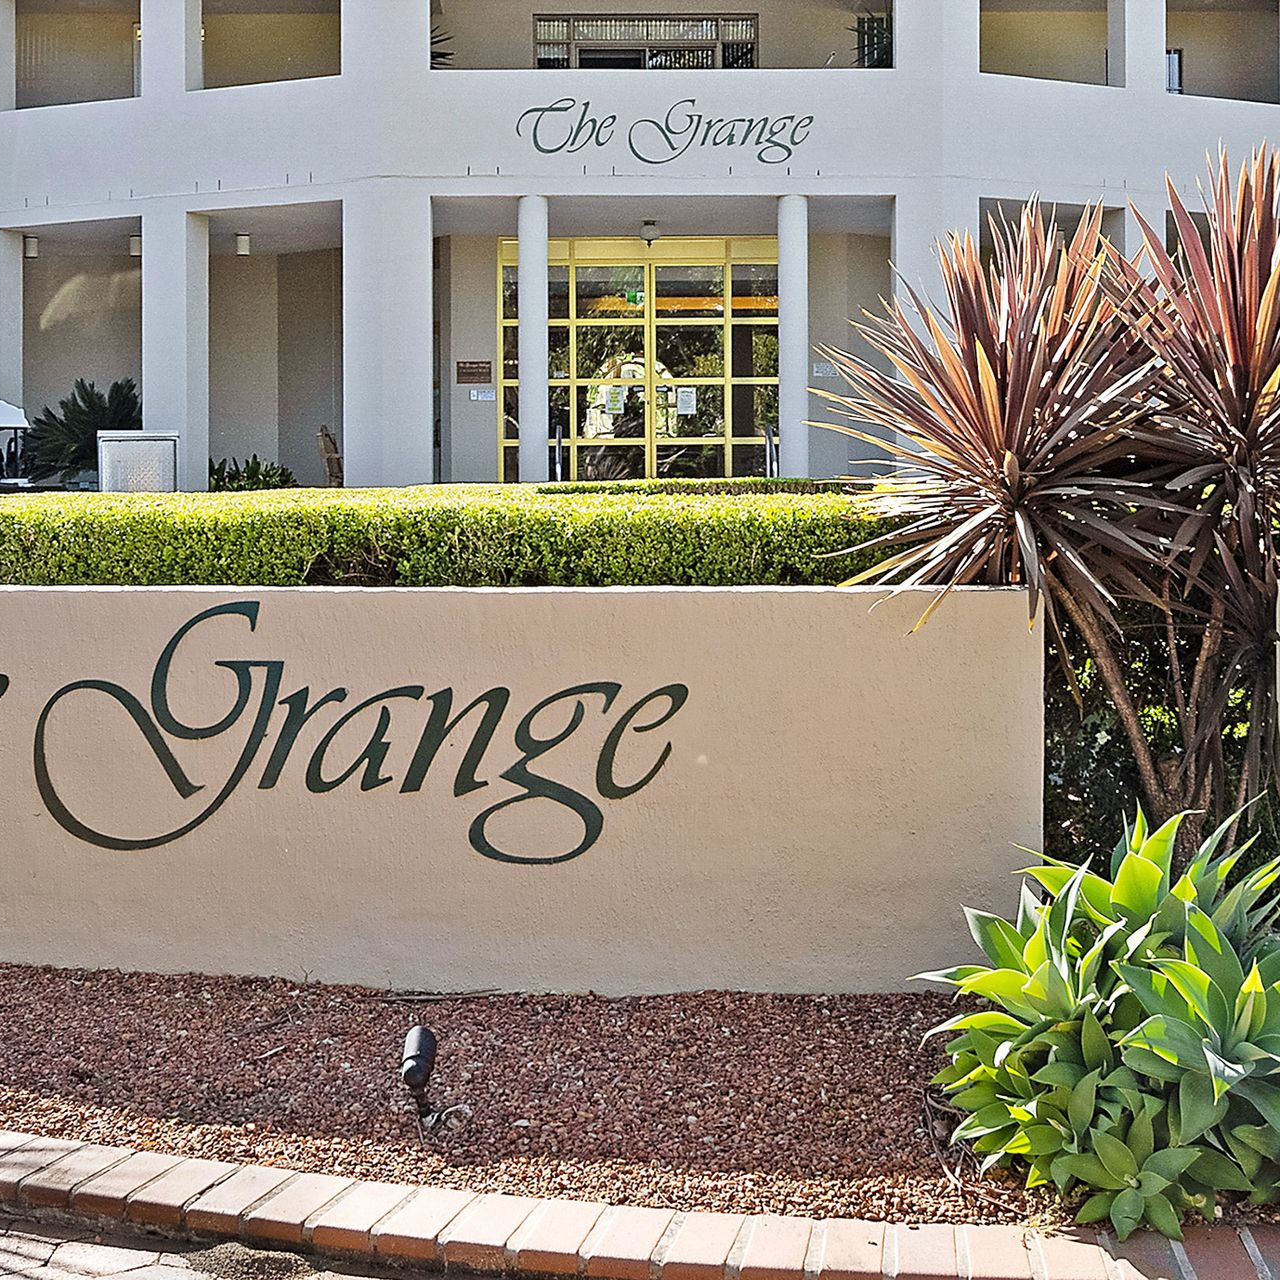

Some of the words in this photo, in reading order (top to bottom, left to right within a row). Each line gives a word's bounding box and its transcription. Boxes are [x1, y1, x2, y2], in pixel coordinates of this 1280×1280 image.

[516, 97, 617, 154] The
[628, 98, 814, 165] Grange
[33, 600, 690, 866] Grange
